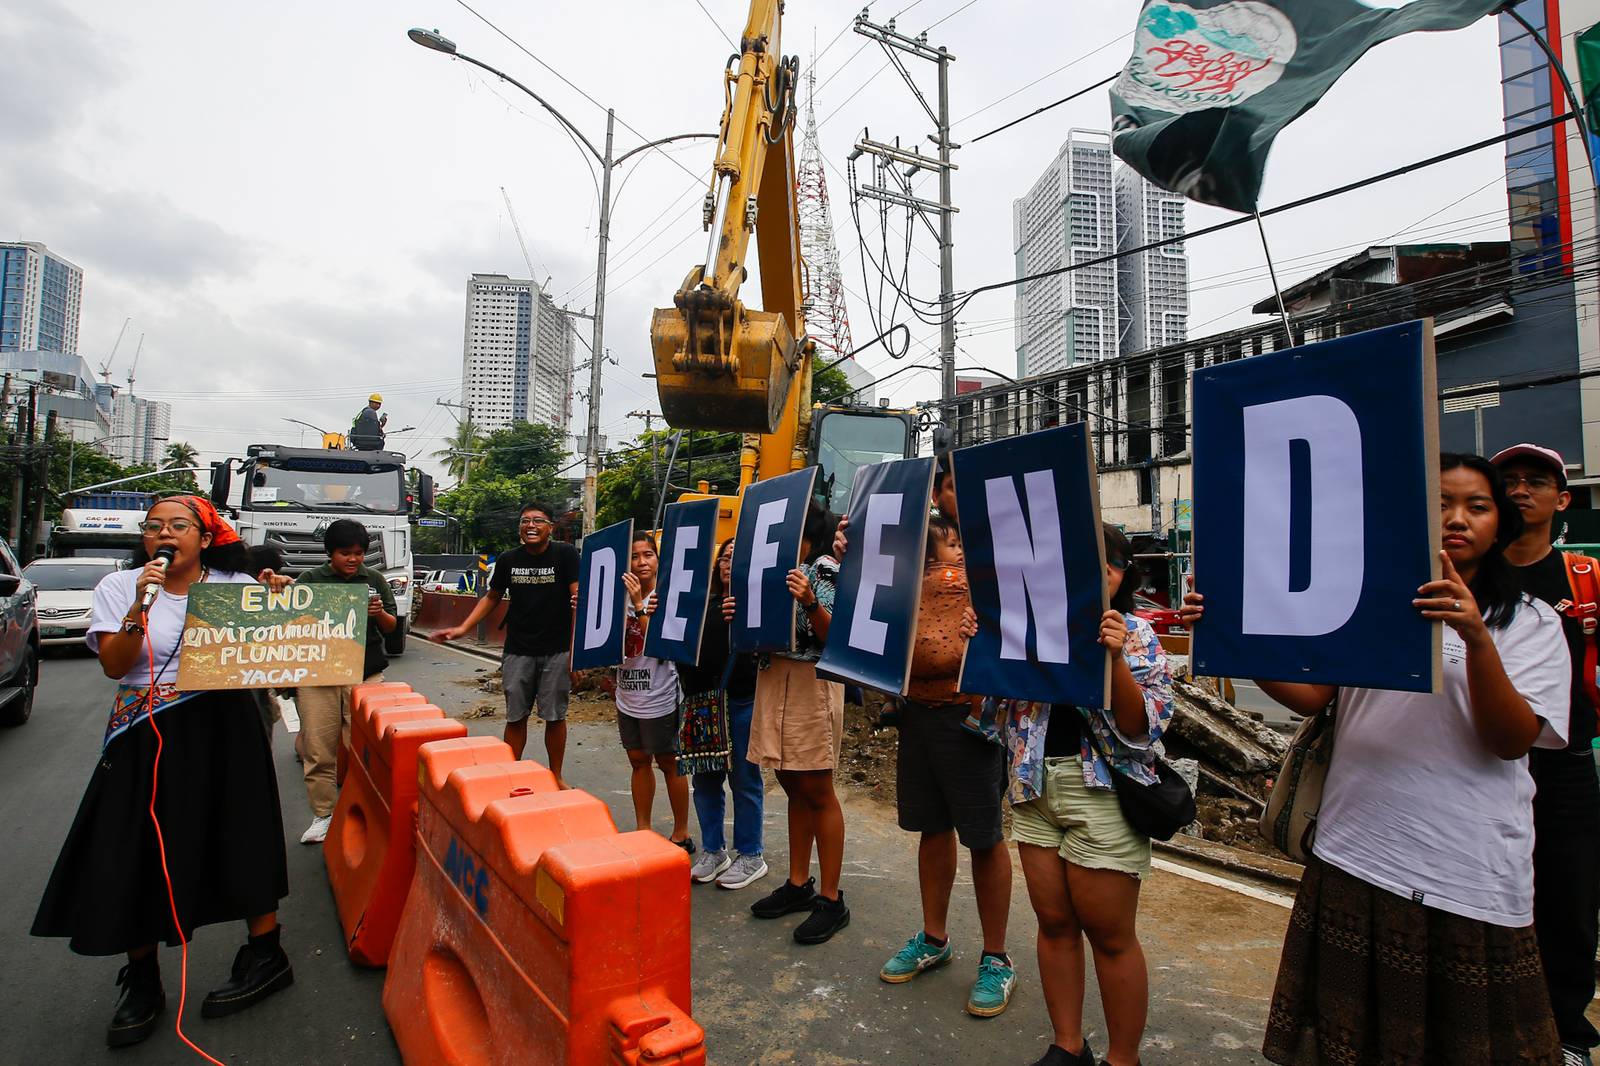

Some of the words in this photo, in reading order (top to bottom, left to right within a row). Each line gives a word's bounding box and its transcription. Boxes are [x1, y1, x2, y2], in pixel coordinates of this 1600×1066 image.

[746, 498, 788, 628] F
[984, 469, 1070, 665] N
[1243, 394, 1365, 636] D
[183, 608, 356, 647] environmental
[241, 585, 313, 612] END
[584, 547, 617, 650] D
[661, 526, 699, 642] E
[848, 493, 904, 656] E
[221, 644, 326, 665] PLUNDER!
